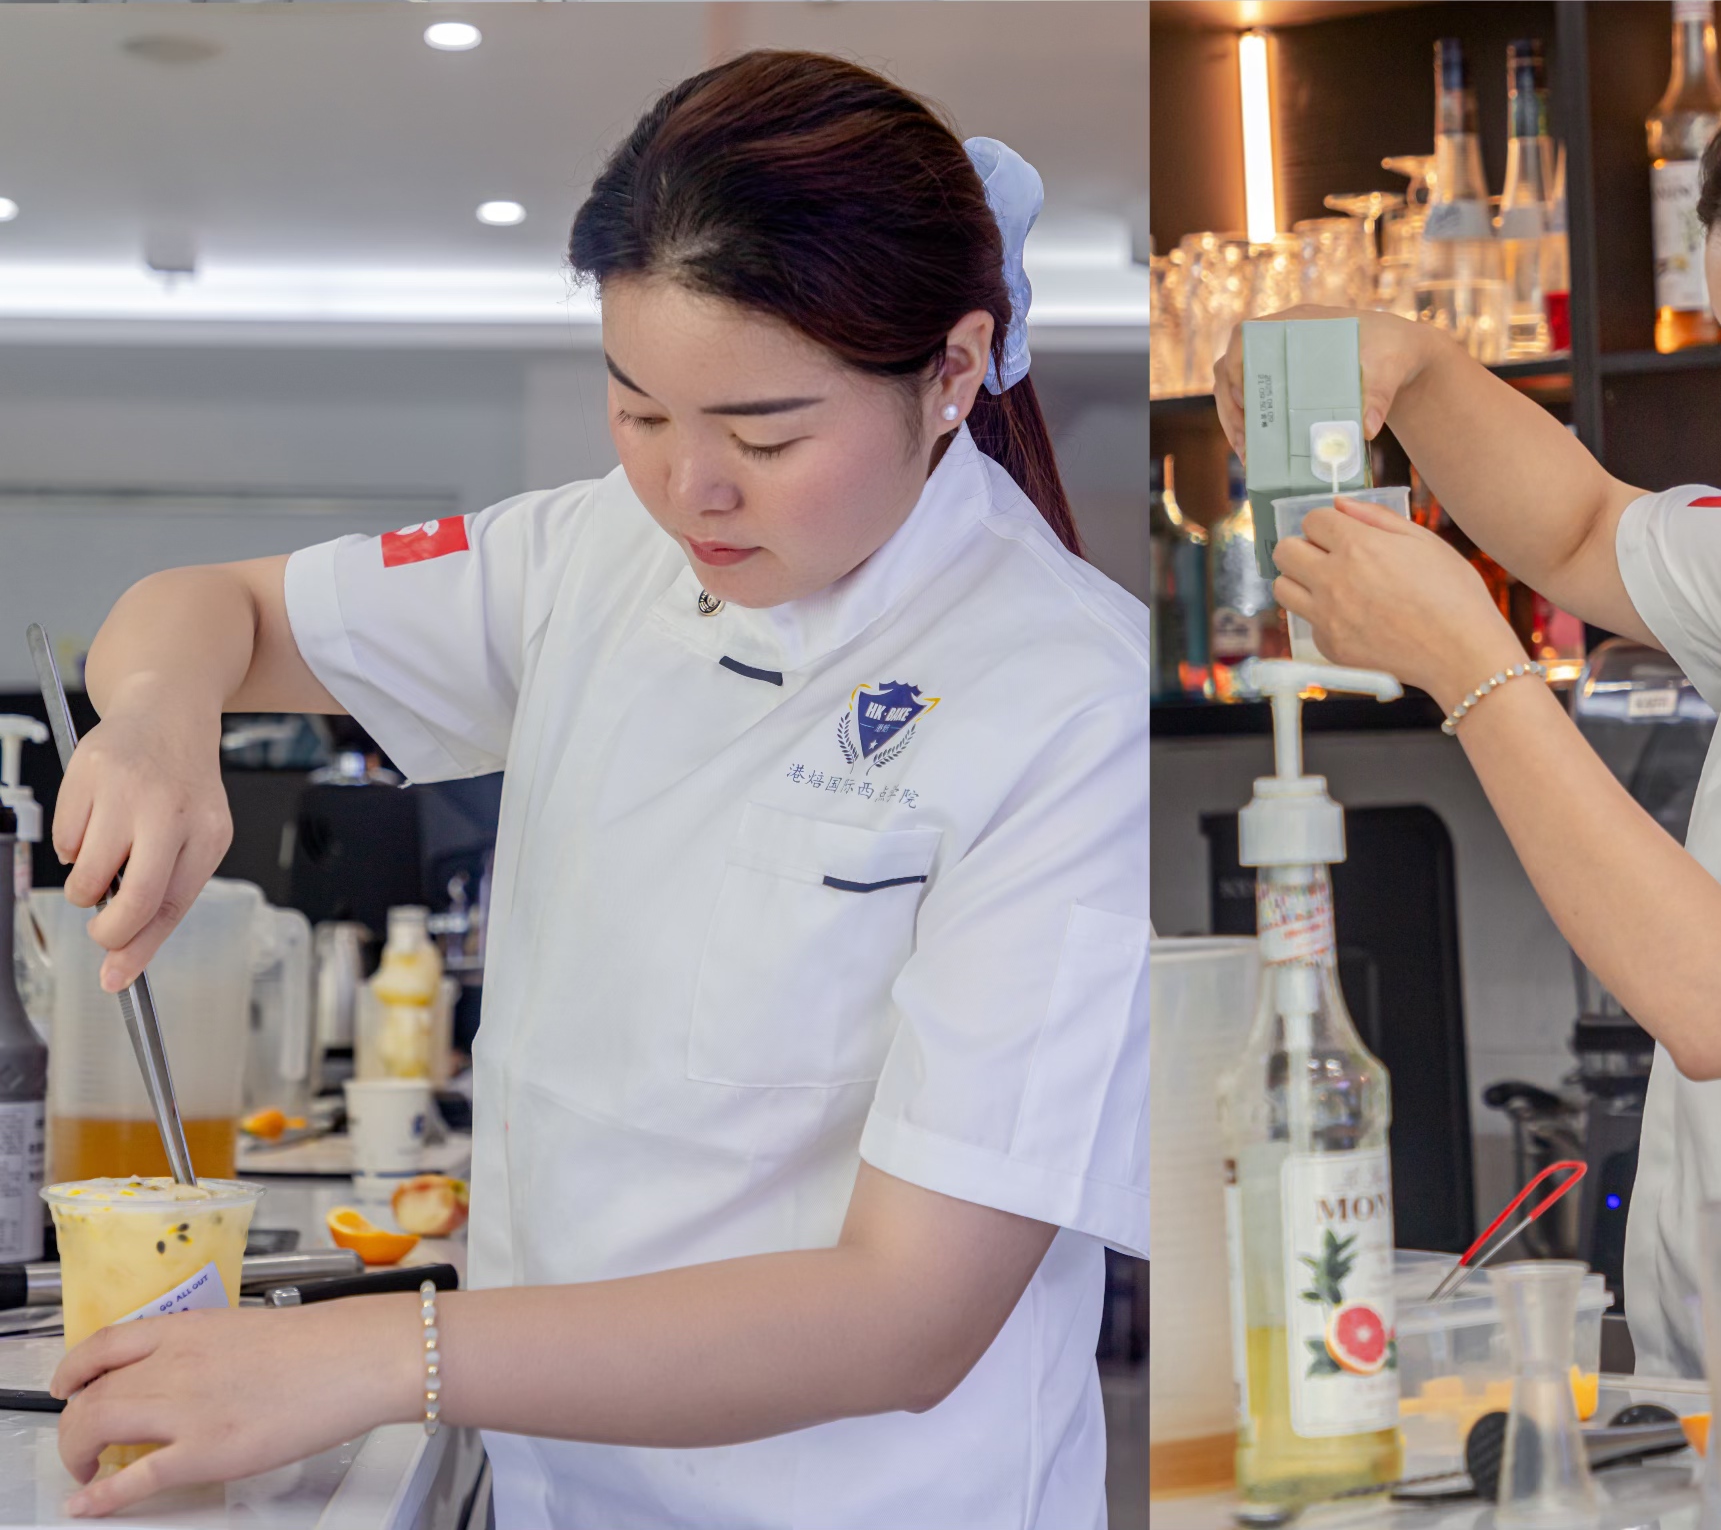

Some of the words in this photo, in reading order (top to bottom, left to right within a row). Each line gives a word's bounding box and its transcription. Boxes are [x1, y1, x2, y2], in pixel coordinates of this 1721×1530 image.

[159, 1299, 174, 1313] GO
[176, 1286, 193, 1303] ALL
[191, 1274, 209, 1291] OUT
